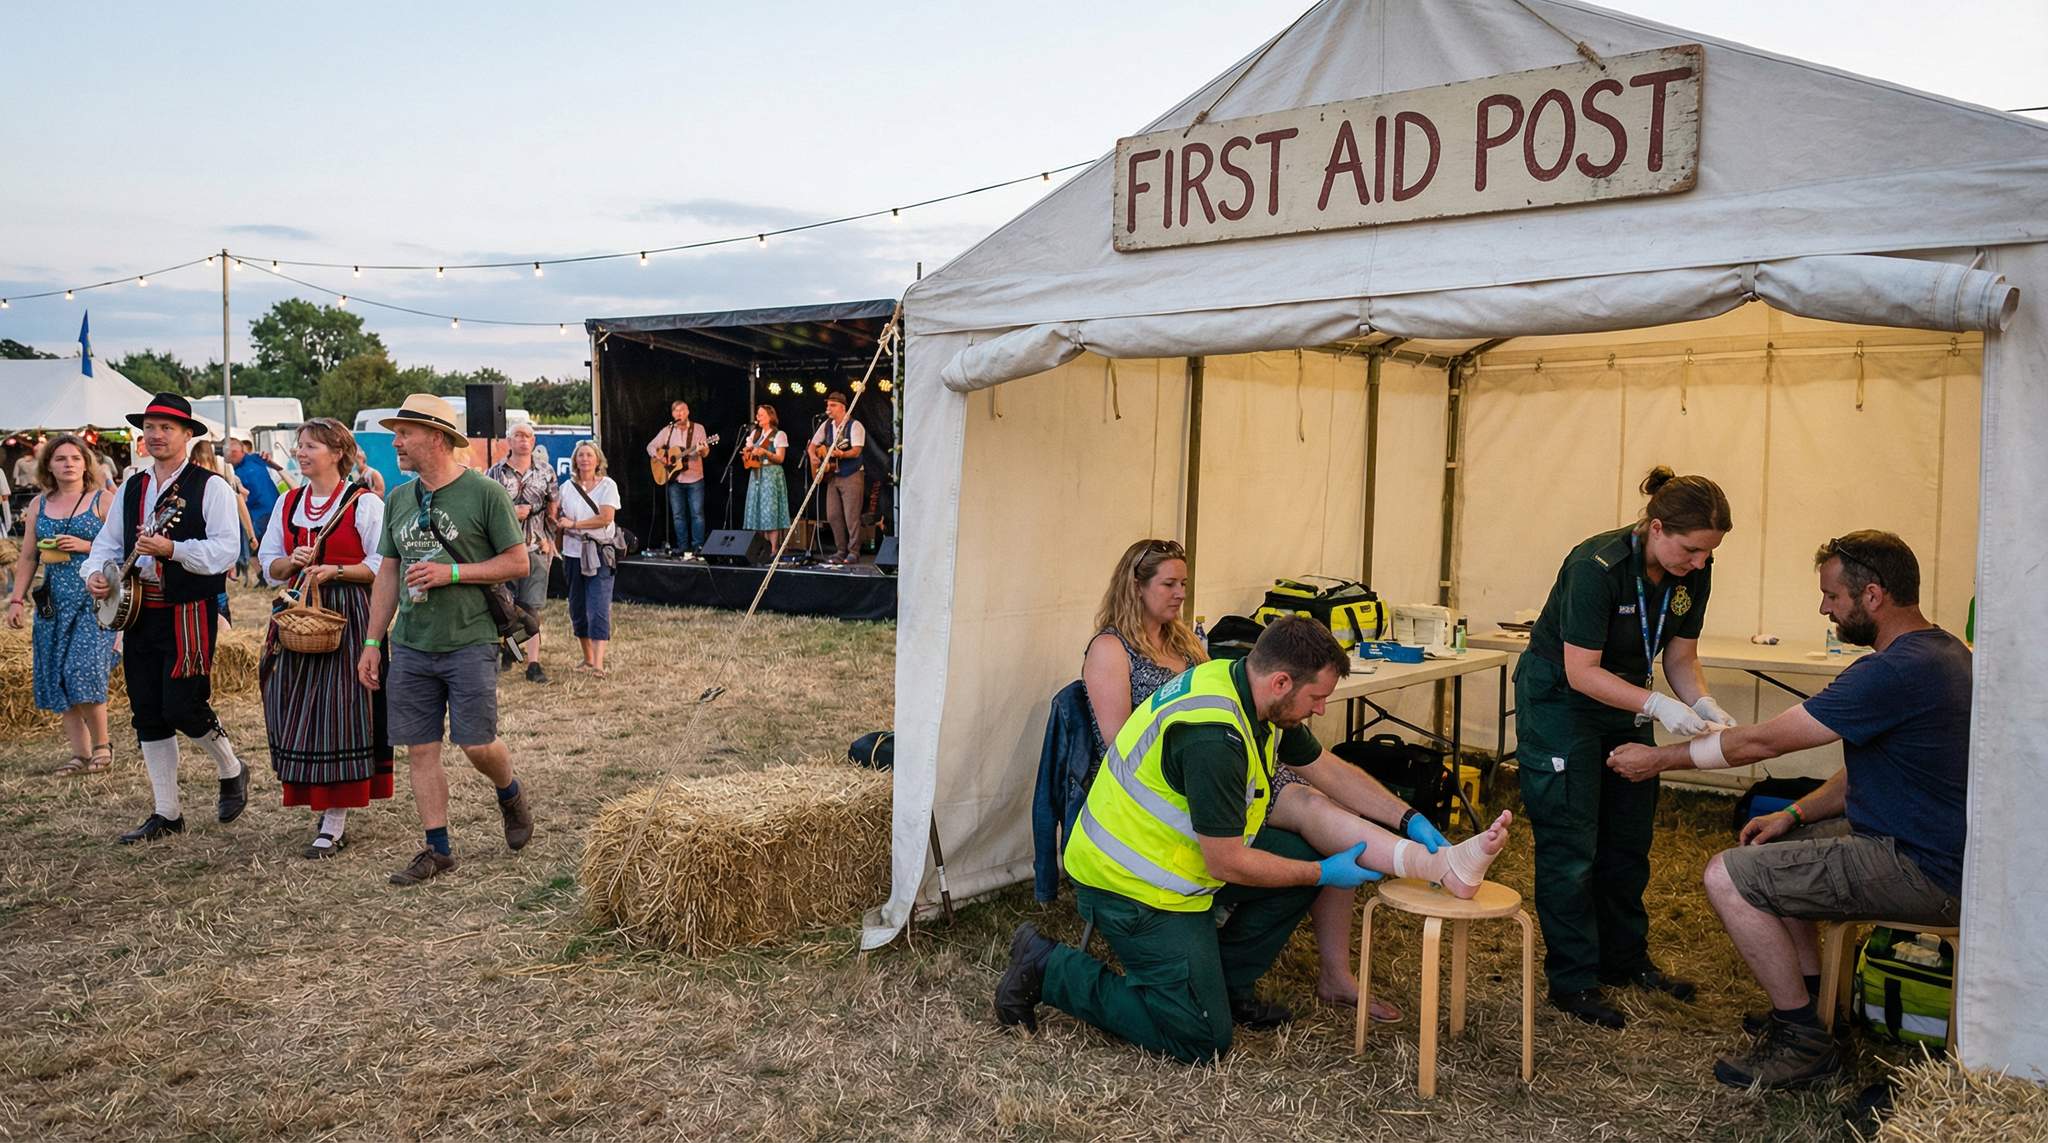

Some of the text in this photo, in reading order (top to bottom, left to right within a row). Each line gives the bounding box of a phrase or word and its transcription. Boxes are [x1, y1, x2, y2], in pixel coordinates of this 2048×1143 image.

[1127, 66, 1693, 234] FIRST AID POST
